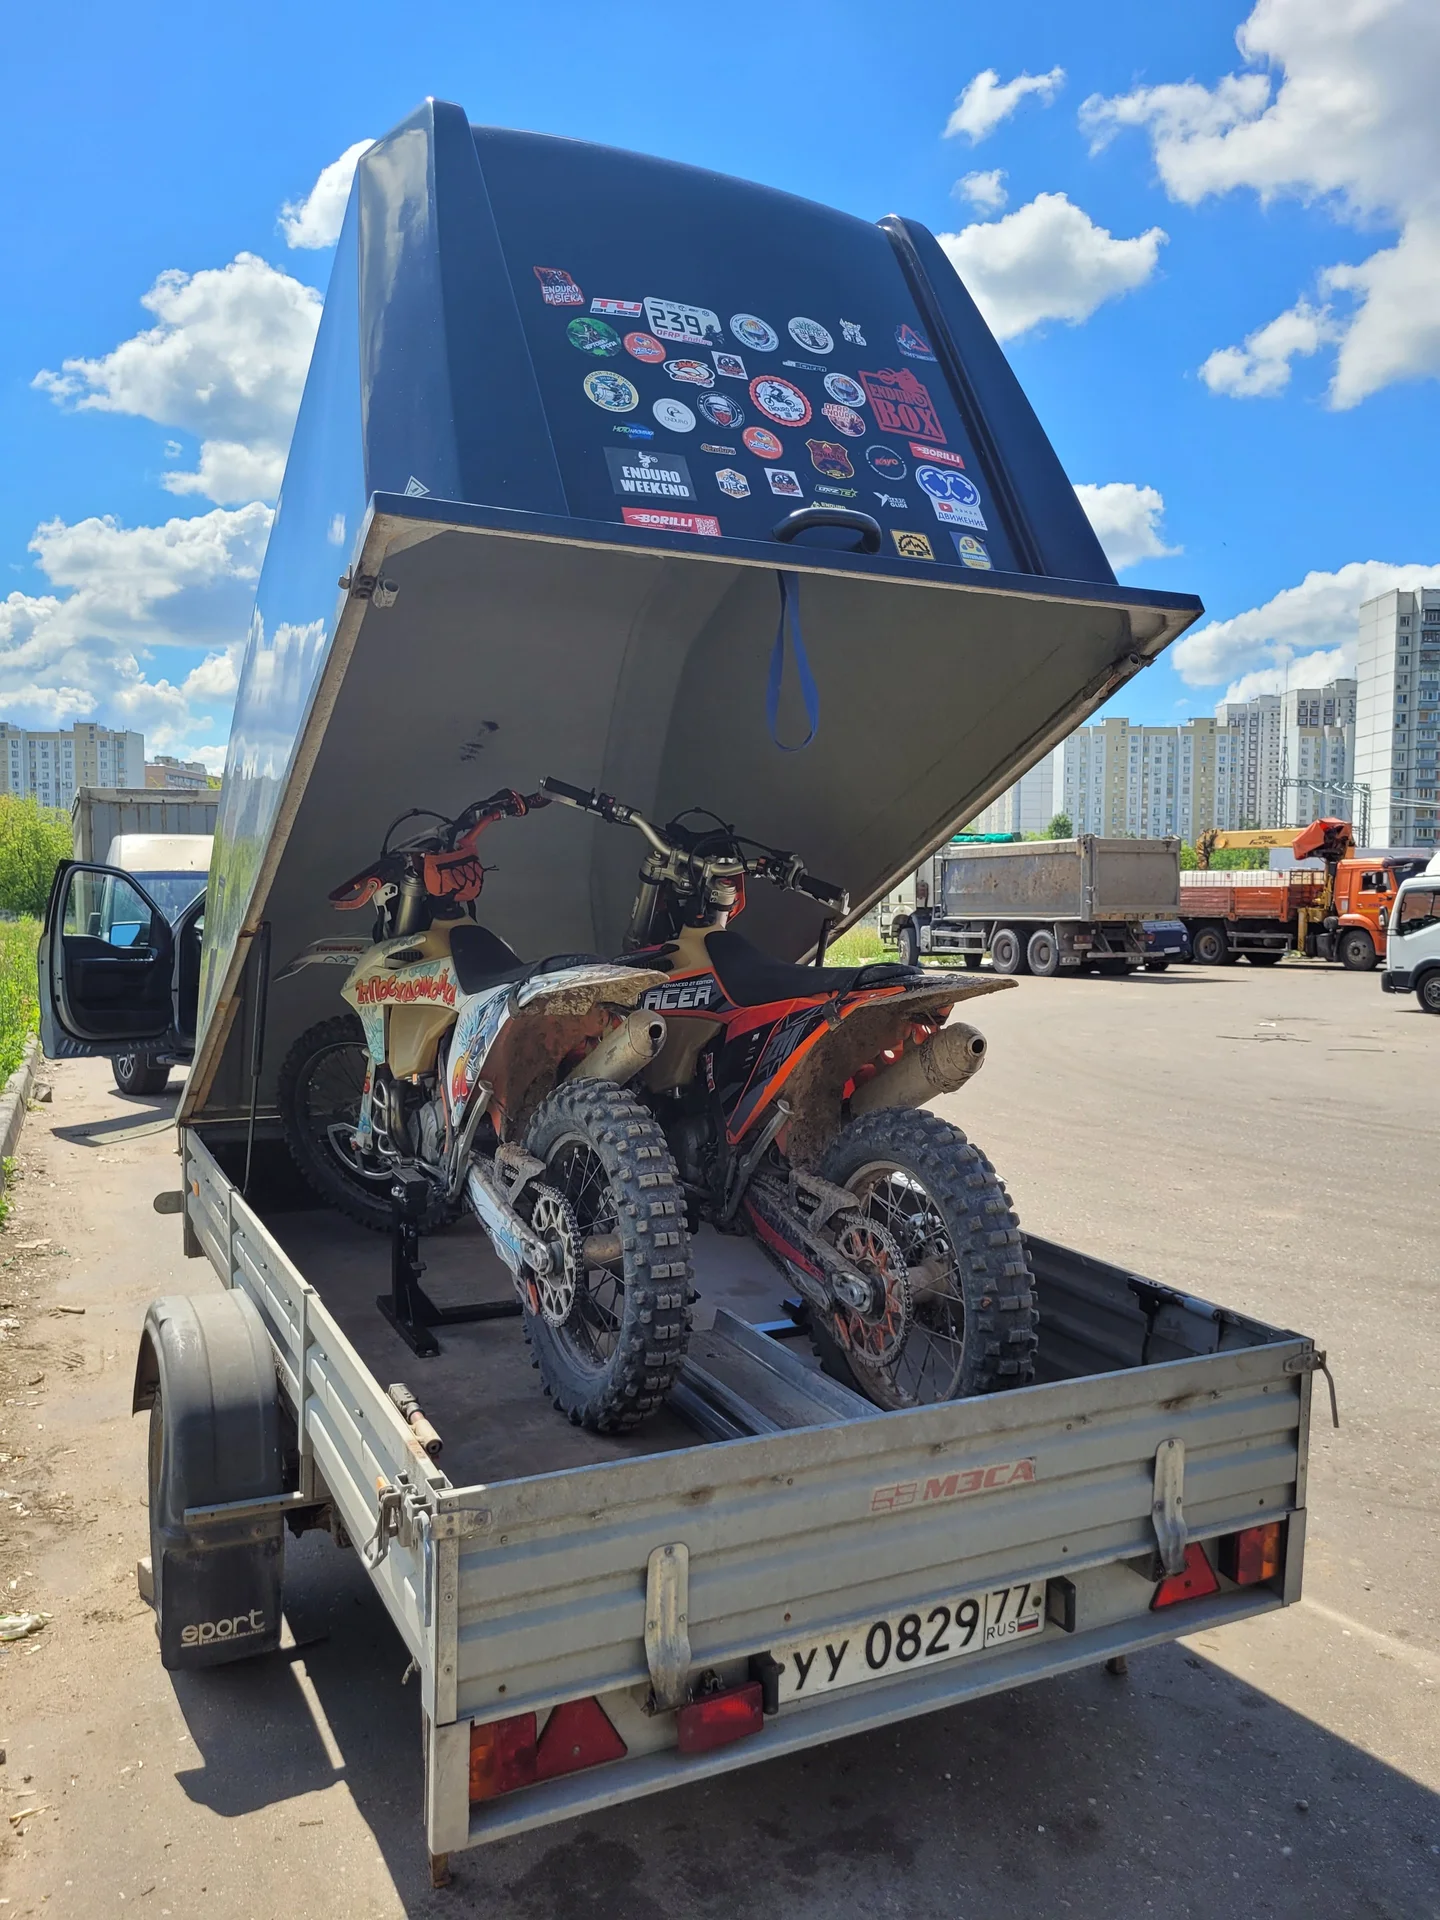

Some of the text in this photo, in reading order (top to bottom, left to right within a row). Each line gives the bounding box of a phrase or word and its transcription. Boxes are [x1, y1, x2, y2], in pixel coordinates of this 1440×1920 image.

[542, 284, 579, 294] ENDURO
[649, 306, 703, 336] 239
[873, 399, 942, 436] BOX
[922, 447, 961, 463] BORILLI
[622, 466, 681, 483] ENDURO
[620, 479, 690, 497] WEEKEND
[639, 513, 693, 527] BORILLI
[938, 512, 986, 528] ДВИЖЕНИЕ
[661, 981, 689, 989] ADVANCED
[640, 984, 713, 1012] ACER
[922, 1458, 1035, 1501] МЗСА
[181, 1609, 265, 1648] sport
[865, 1598, 980, 1670] 0829
[992, 1583, 1032, 1625] 77
[986, 1621, 1016, 1640] RUS
